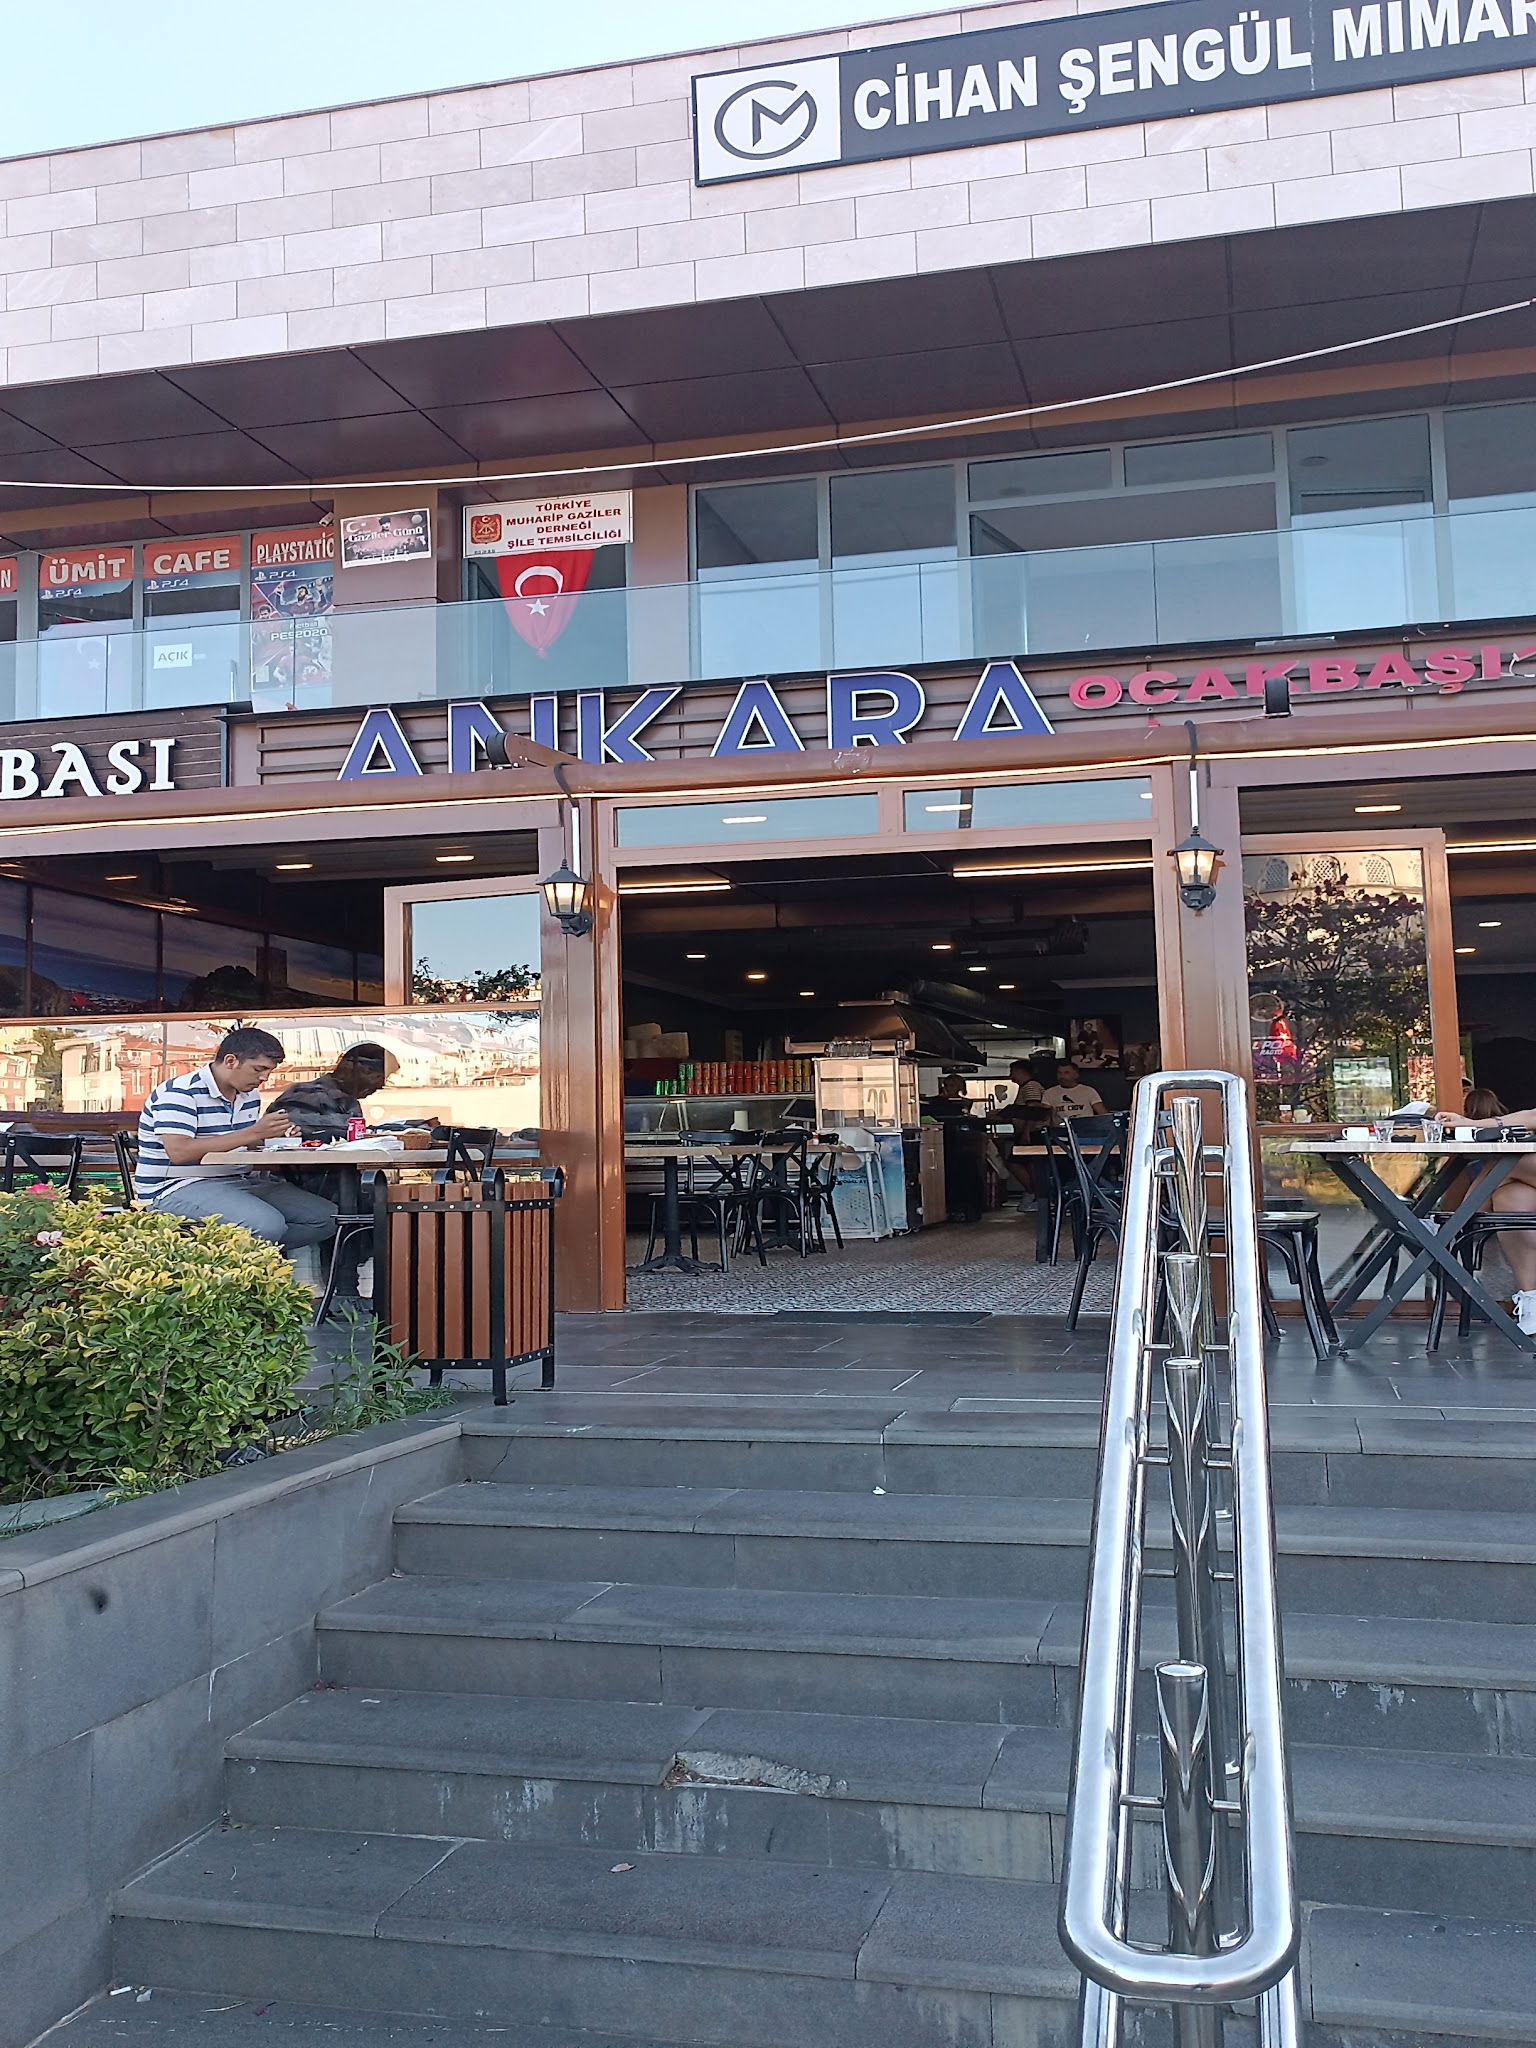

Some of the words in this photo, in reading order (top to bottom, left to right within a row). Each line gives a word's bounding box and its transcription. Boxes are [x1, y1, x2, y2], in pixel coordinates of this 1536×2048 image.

[853, 55, 1038, 131] CİHAN
[1058, 10, 1312, 114] ŞENGÜL
[536, 500, 592, 512] TÜRKİYE
[506, 514, 564, 526] MUHARİP
[567, 508, 622, 520] GAZİLER
[536, 521, 592, 534] DERNEĞİ
[507, 538, 535, 549] ŞİLE
[538, 529, 622, 545] TEMSİLCİLİĞİ
[49, 553, 126, 585] ÜMİT
[153, 549, 230, 575] CAFE
[269, 570, 297, 579] PS4
[162, 579, 189, 588] PS4
[55, 588, 82, 598] PS4
[158, 650, 188, 662] AÇIK
[336, 661, 1055, 781] ANKARA
[1069, 645, 1502, 709] OCAKBAŞI
[1412, 1037, 1433, 1045] fus
